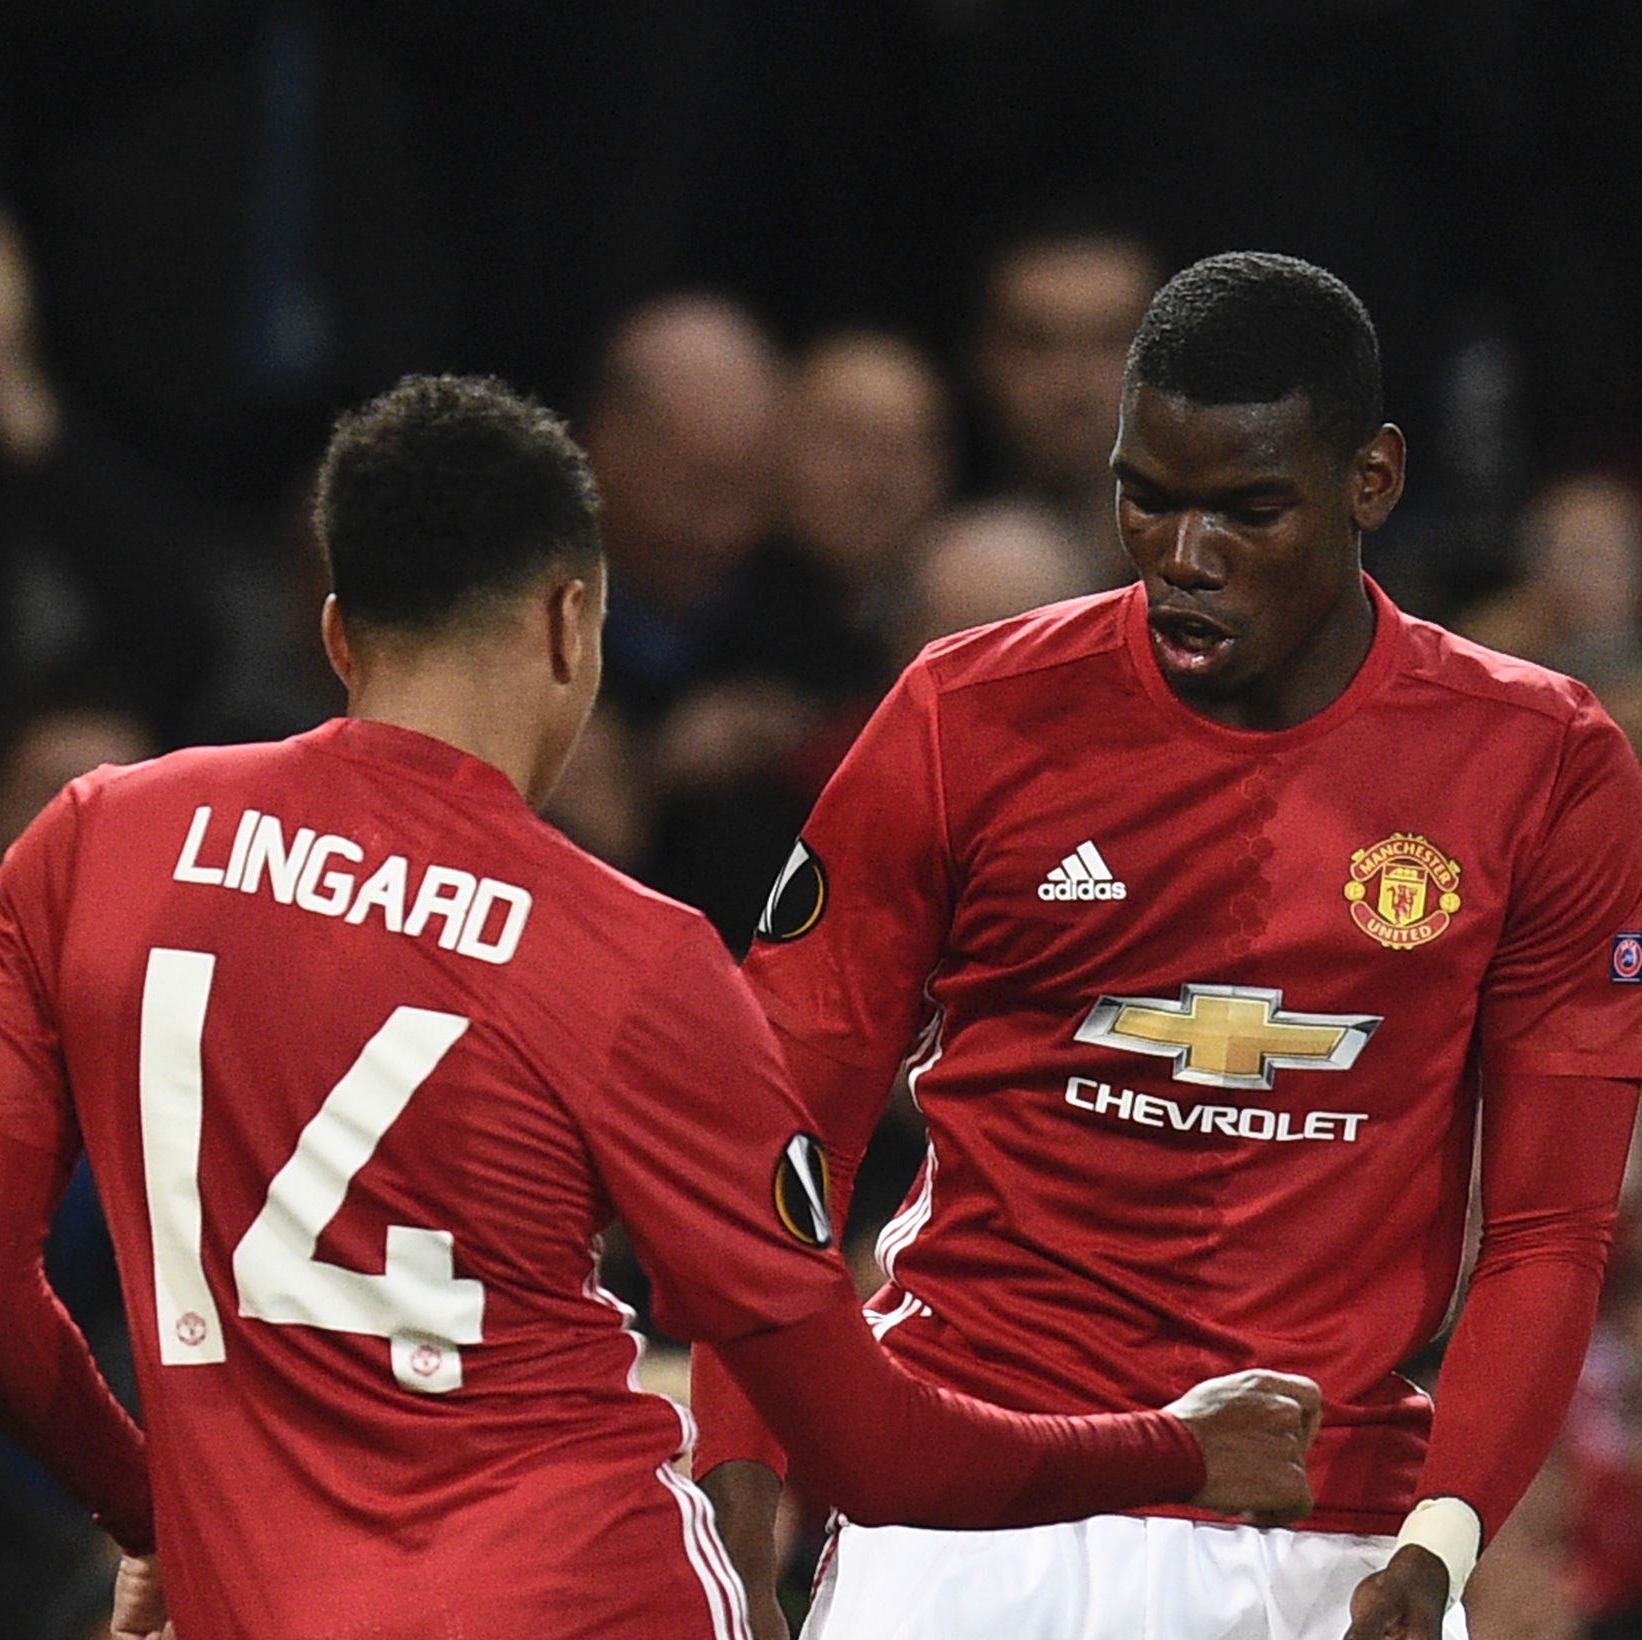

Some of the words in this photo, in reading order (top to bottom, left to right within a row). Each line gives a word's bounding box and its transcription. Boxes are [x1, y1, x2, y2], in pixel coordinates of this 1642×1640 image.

[172, 805, 533, 965] LINGARD
[1037, 879, 1127, 901] adidas
[1359, 842, 1451, 885] MANCHESTER
[1366, 918, 1432, 942] UNITED
[1065, 1076, 1369, 1142] CHEVROLET
[140, 948, 484, 1393] 14
